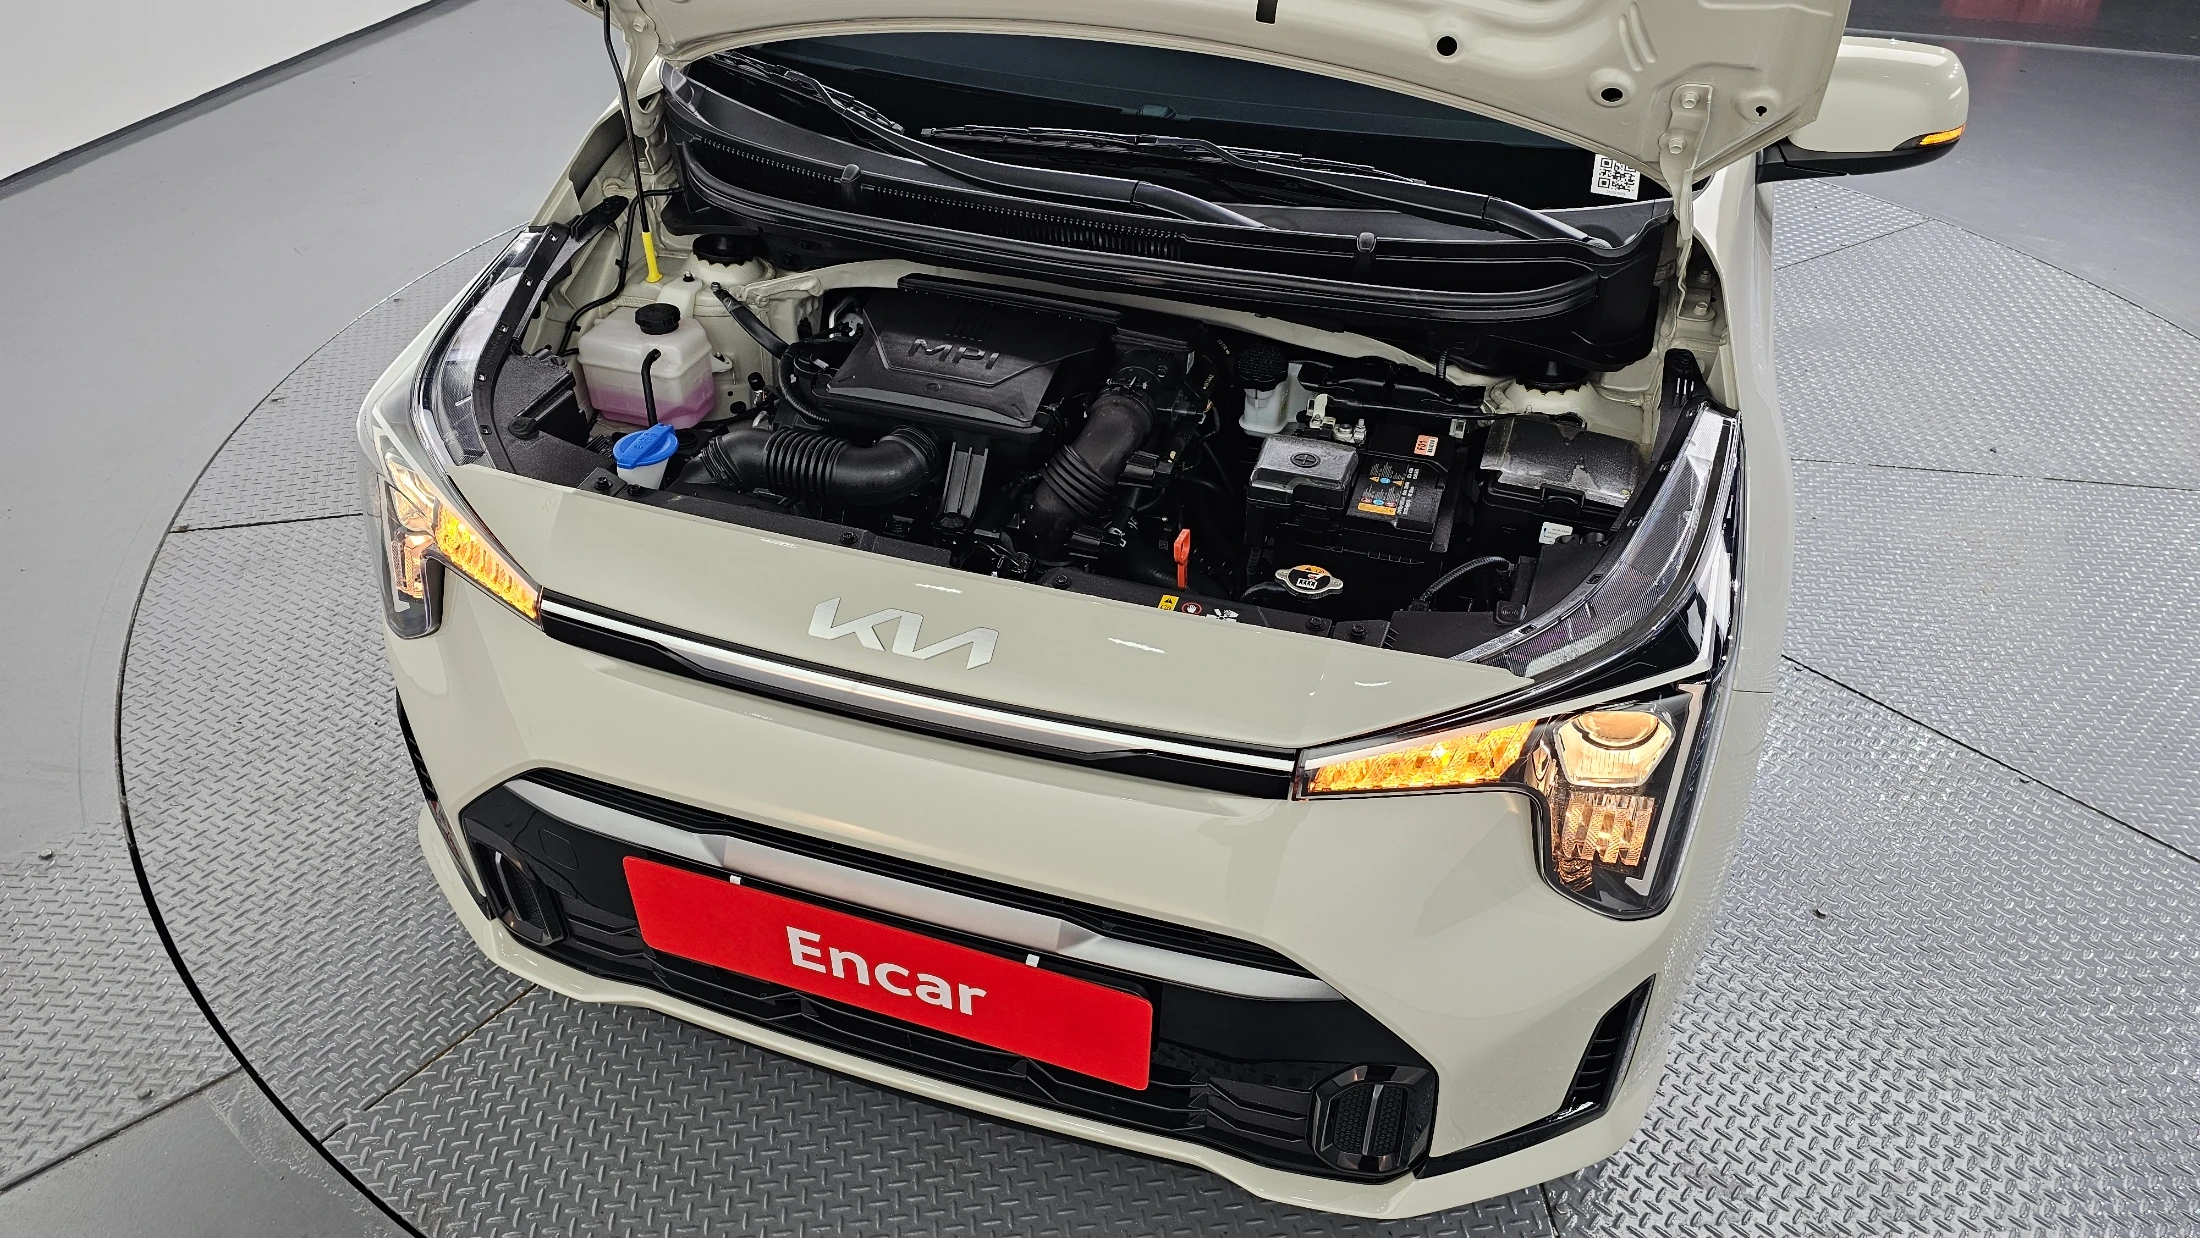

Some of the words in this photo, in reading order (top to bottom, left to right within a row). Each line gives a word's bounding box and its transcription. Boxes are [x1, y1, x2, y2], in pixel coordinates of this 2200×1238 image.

[908, 338, 1000, 370] MPI
[808, 597, 999, 670] KIA
[786, 925, 987, 1016] Encar
